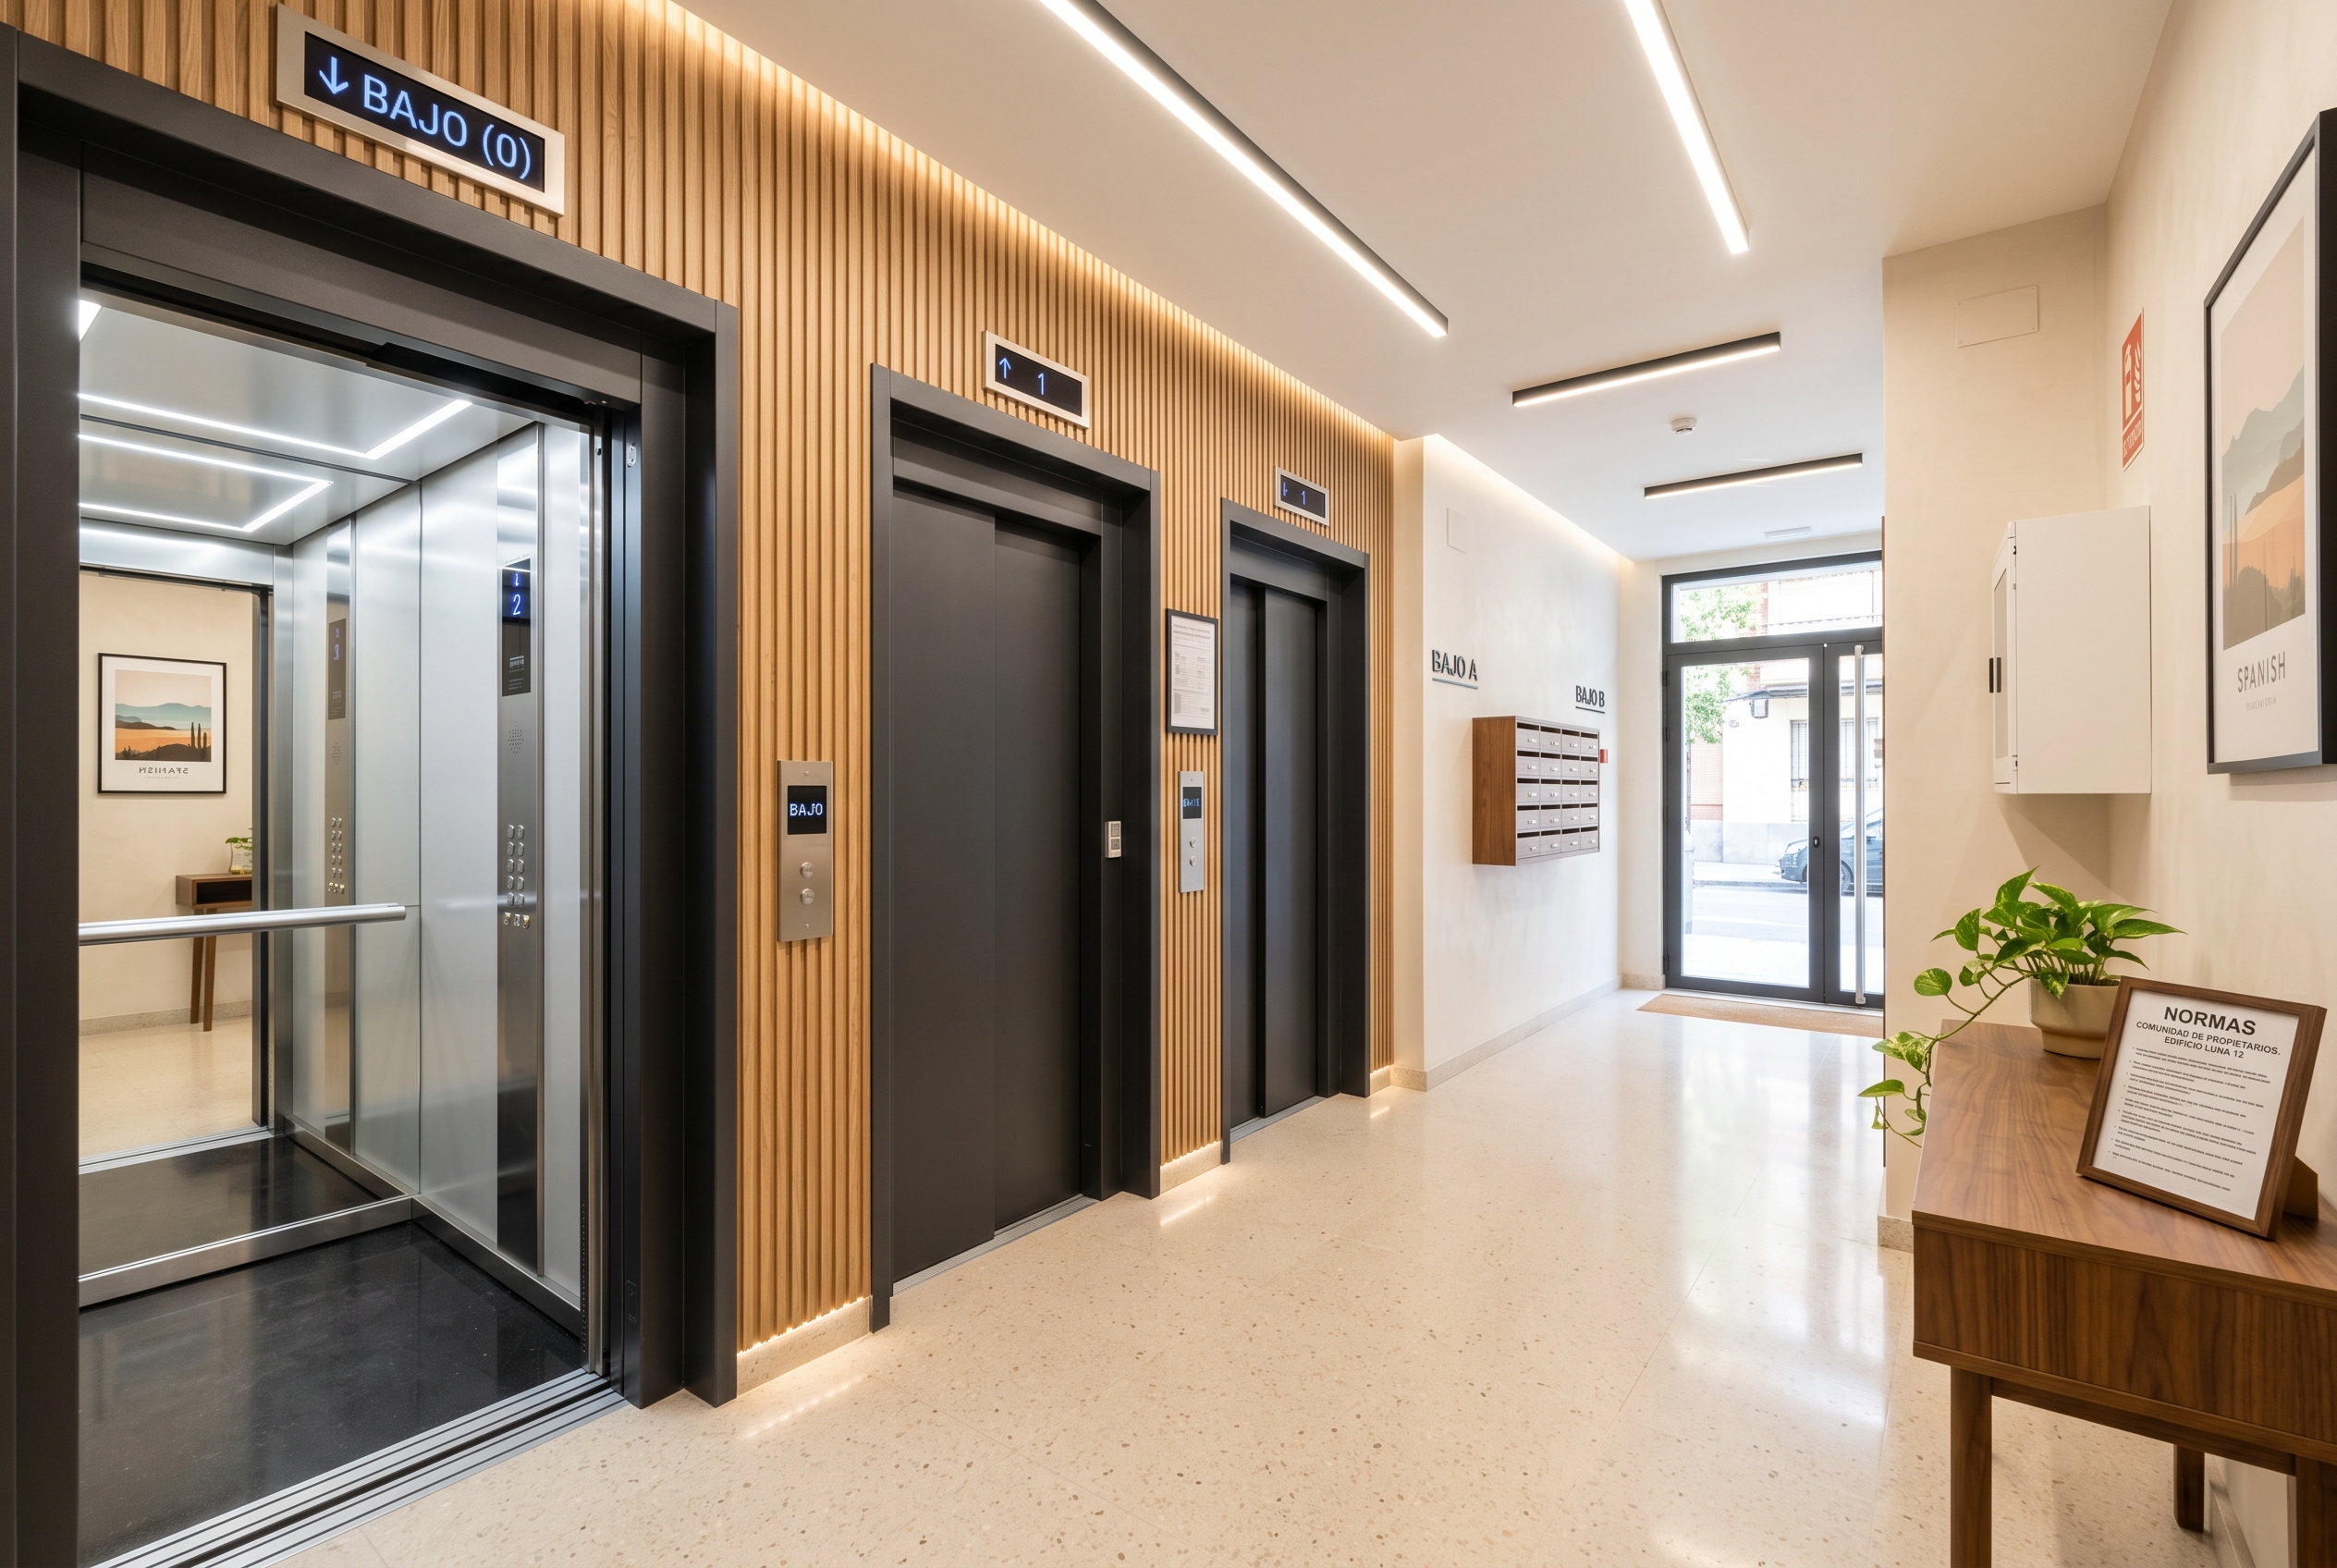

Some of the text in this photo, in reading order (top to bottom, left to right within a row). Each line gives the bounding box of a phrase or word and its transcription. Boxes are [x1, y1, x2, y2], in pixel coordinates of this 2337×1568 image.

[363, 73, 531, 180] BAJO (0)
[1037, 373, 1045, 396] 1
[1301, 490, 1306, 506] 1
[512, 594, 521, 616] 2
[1432, 649, 1478, 681] BAJO A
[2237, 651, 2286, 693] SPANISH
[1575, 685, 1605, 707] BAJO B
[789, 803, 823, 815] BAJO
[2163, 1006, 2257, 1036] NORMAS
[2135, 1021, 2282, 1056] COMUNIDAD DE PROPIETARIOS.
[2164, 1035, 2245, 1060] EDIFICIO LUNA 12
